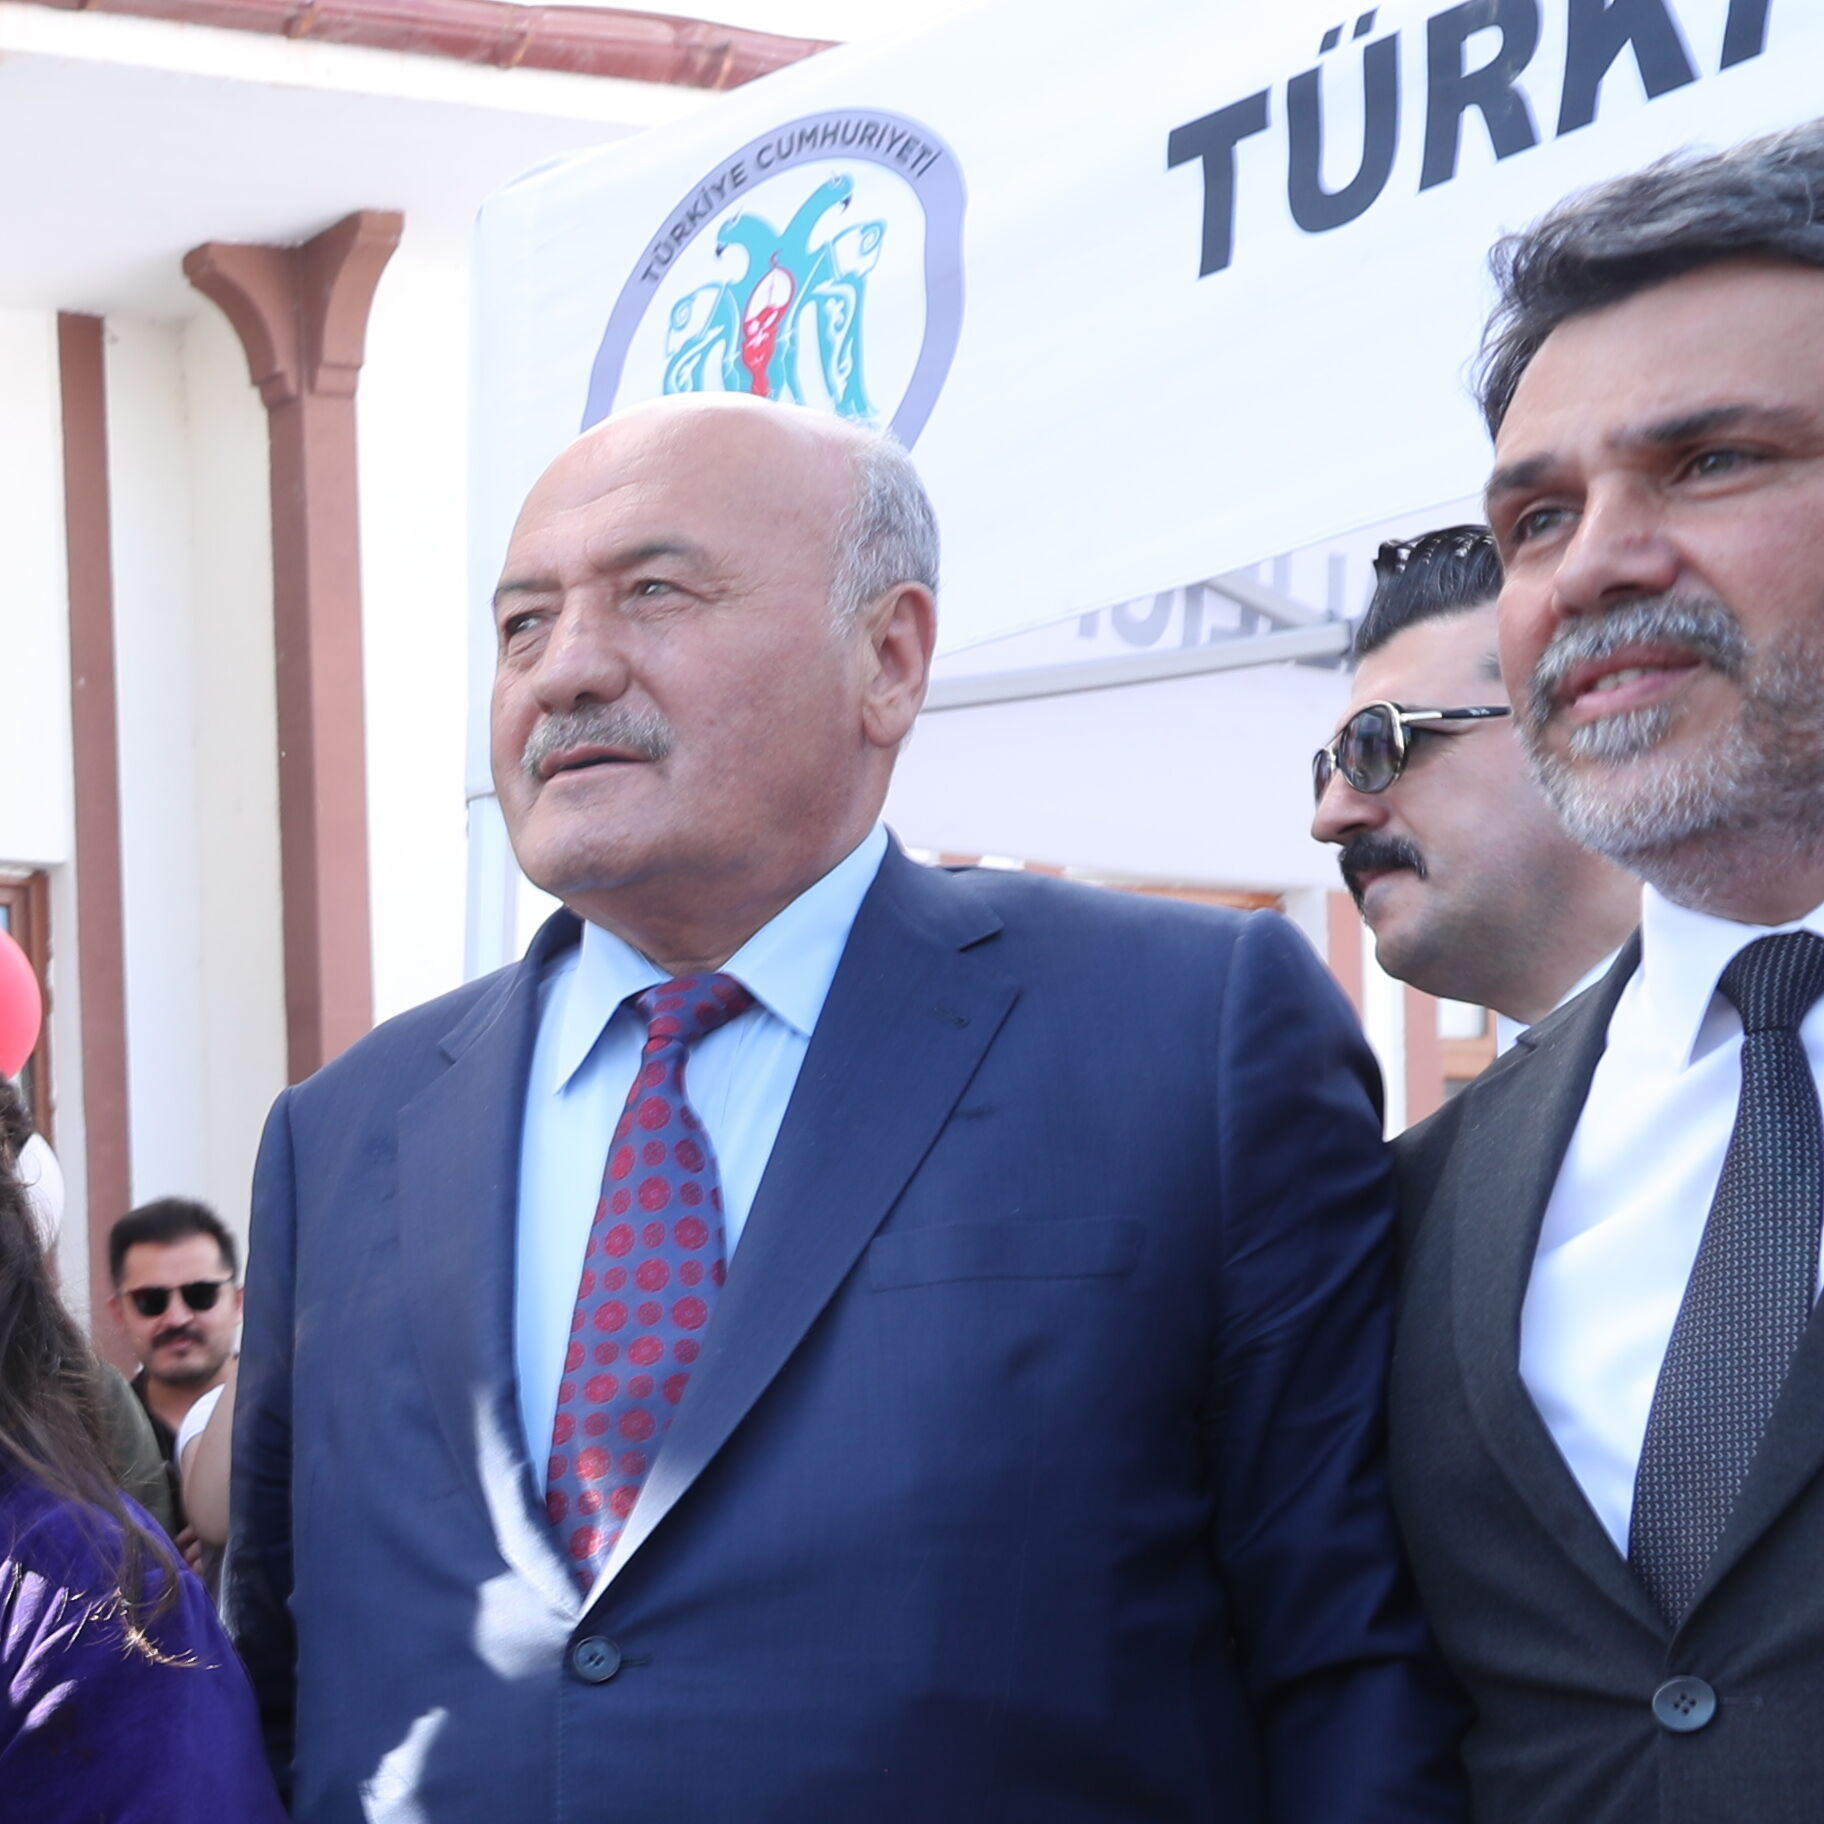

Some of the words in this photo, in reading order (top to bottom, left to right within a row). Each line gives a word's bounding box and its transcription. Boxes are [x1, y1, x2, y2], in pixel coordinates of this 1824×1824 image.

[640, 160, 749, 283] TÜRKİYE
[755, 119, 943, 179] CUMHURİYETİ
[1166, 0, 1774, 279] TÜRK
